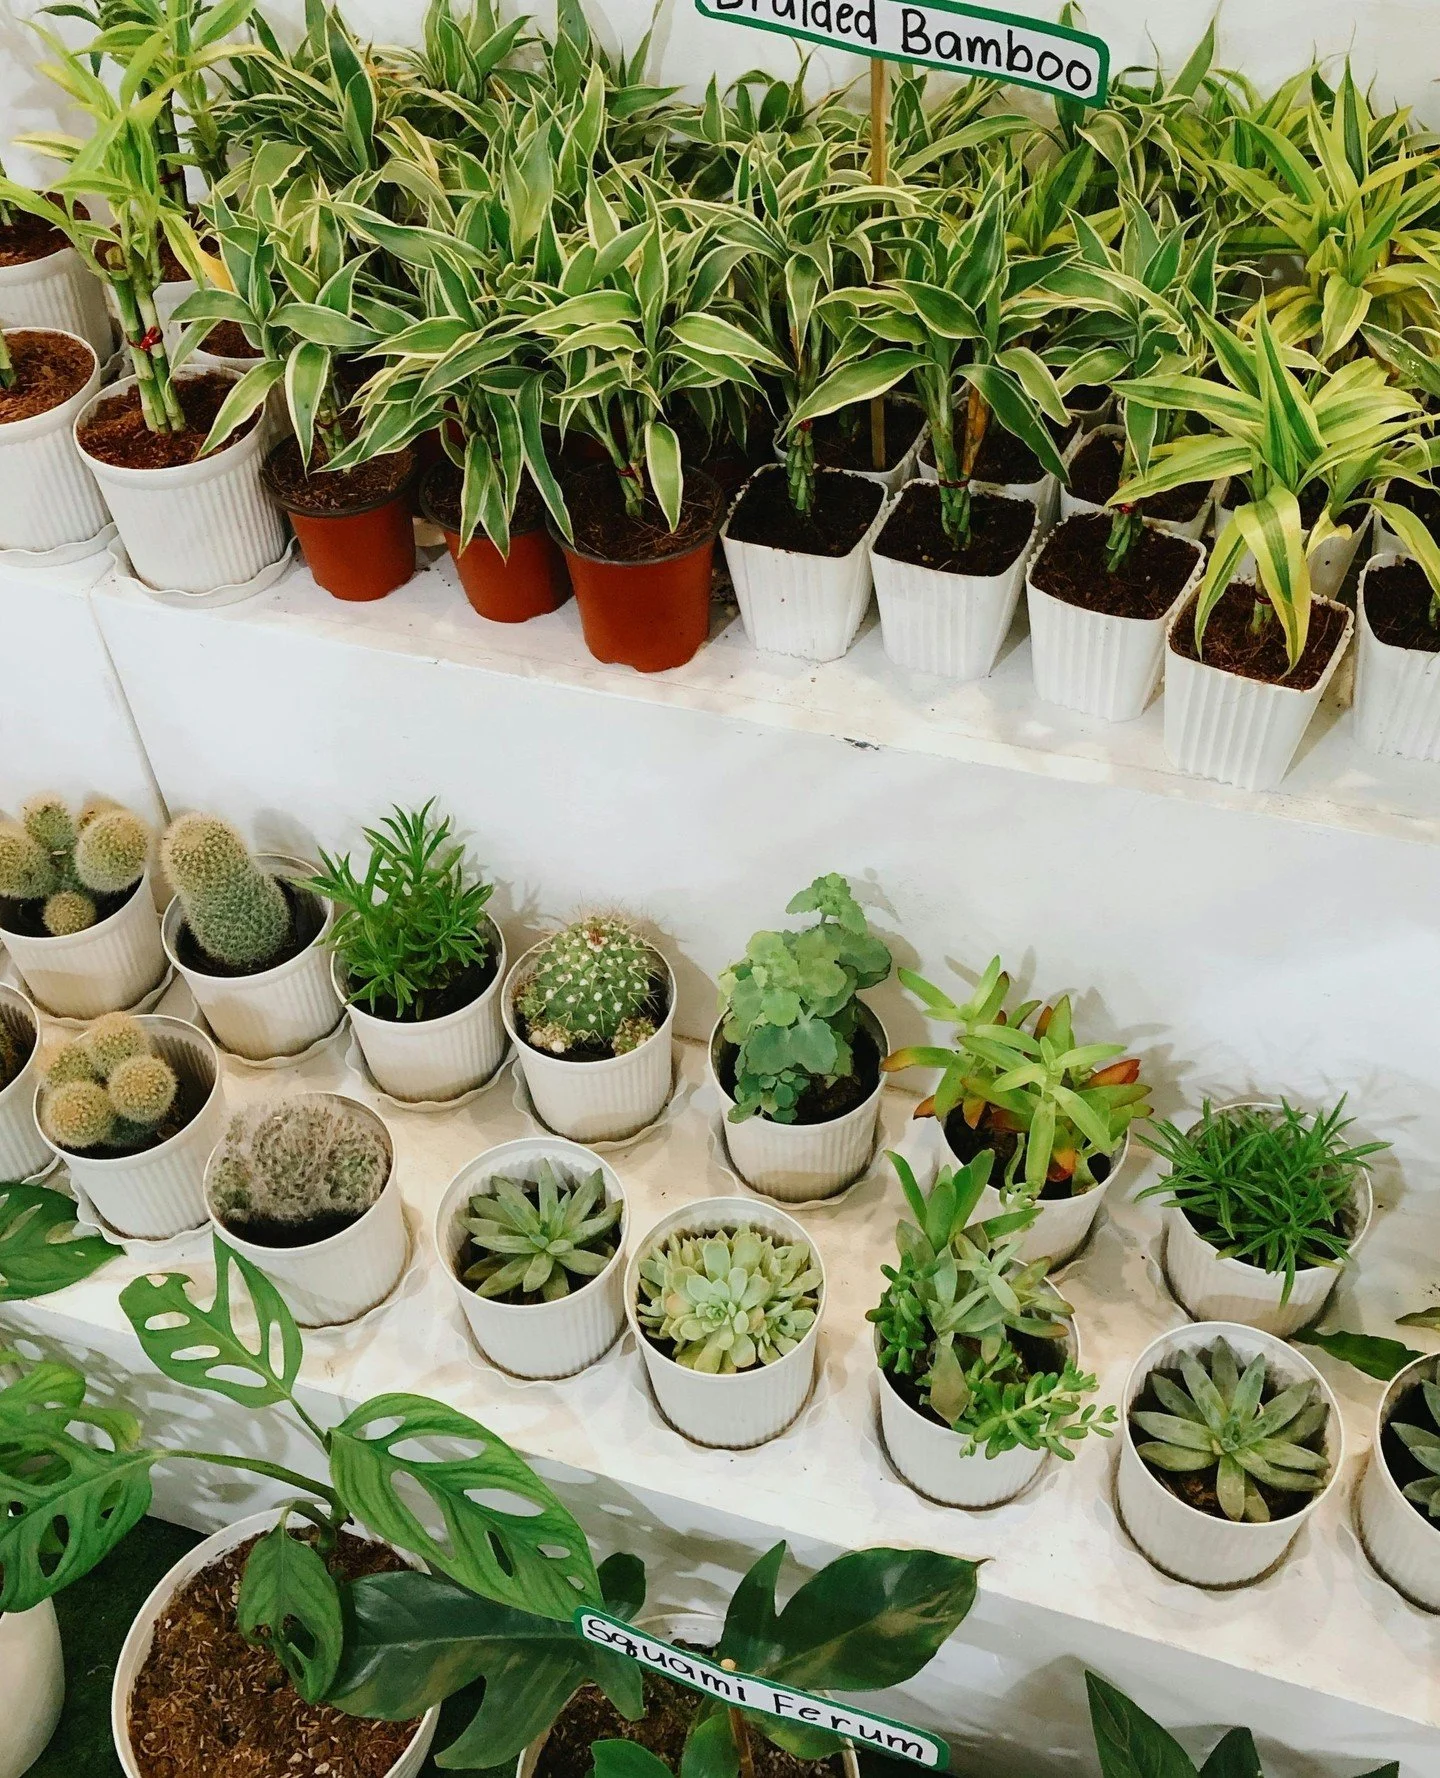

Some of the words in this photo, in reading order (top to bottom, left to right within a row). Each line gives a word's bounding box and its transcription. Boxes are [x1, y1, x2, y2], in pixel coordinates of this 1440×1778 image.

[716, 0, 877, 44] aided
[901, 9, 1092, 90] Bamboo
[587, 1619, 746, 1701] Squami
[774, 1694, 923, 1759] Ferum
